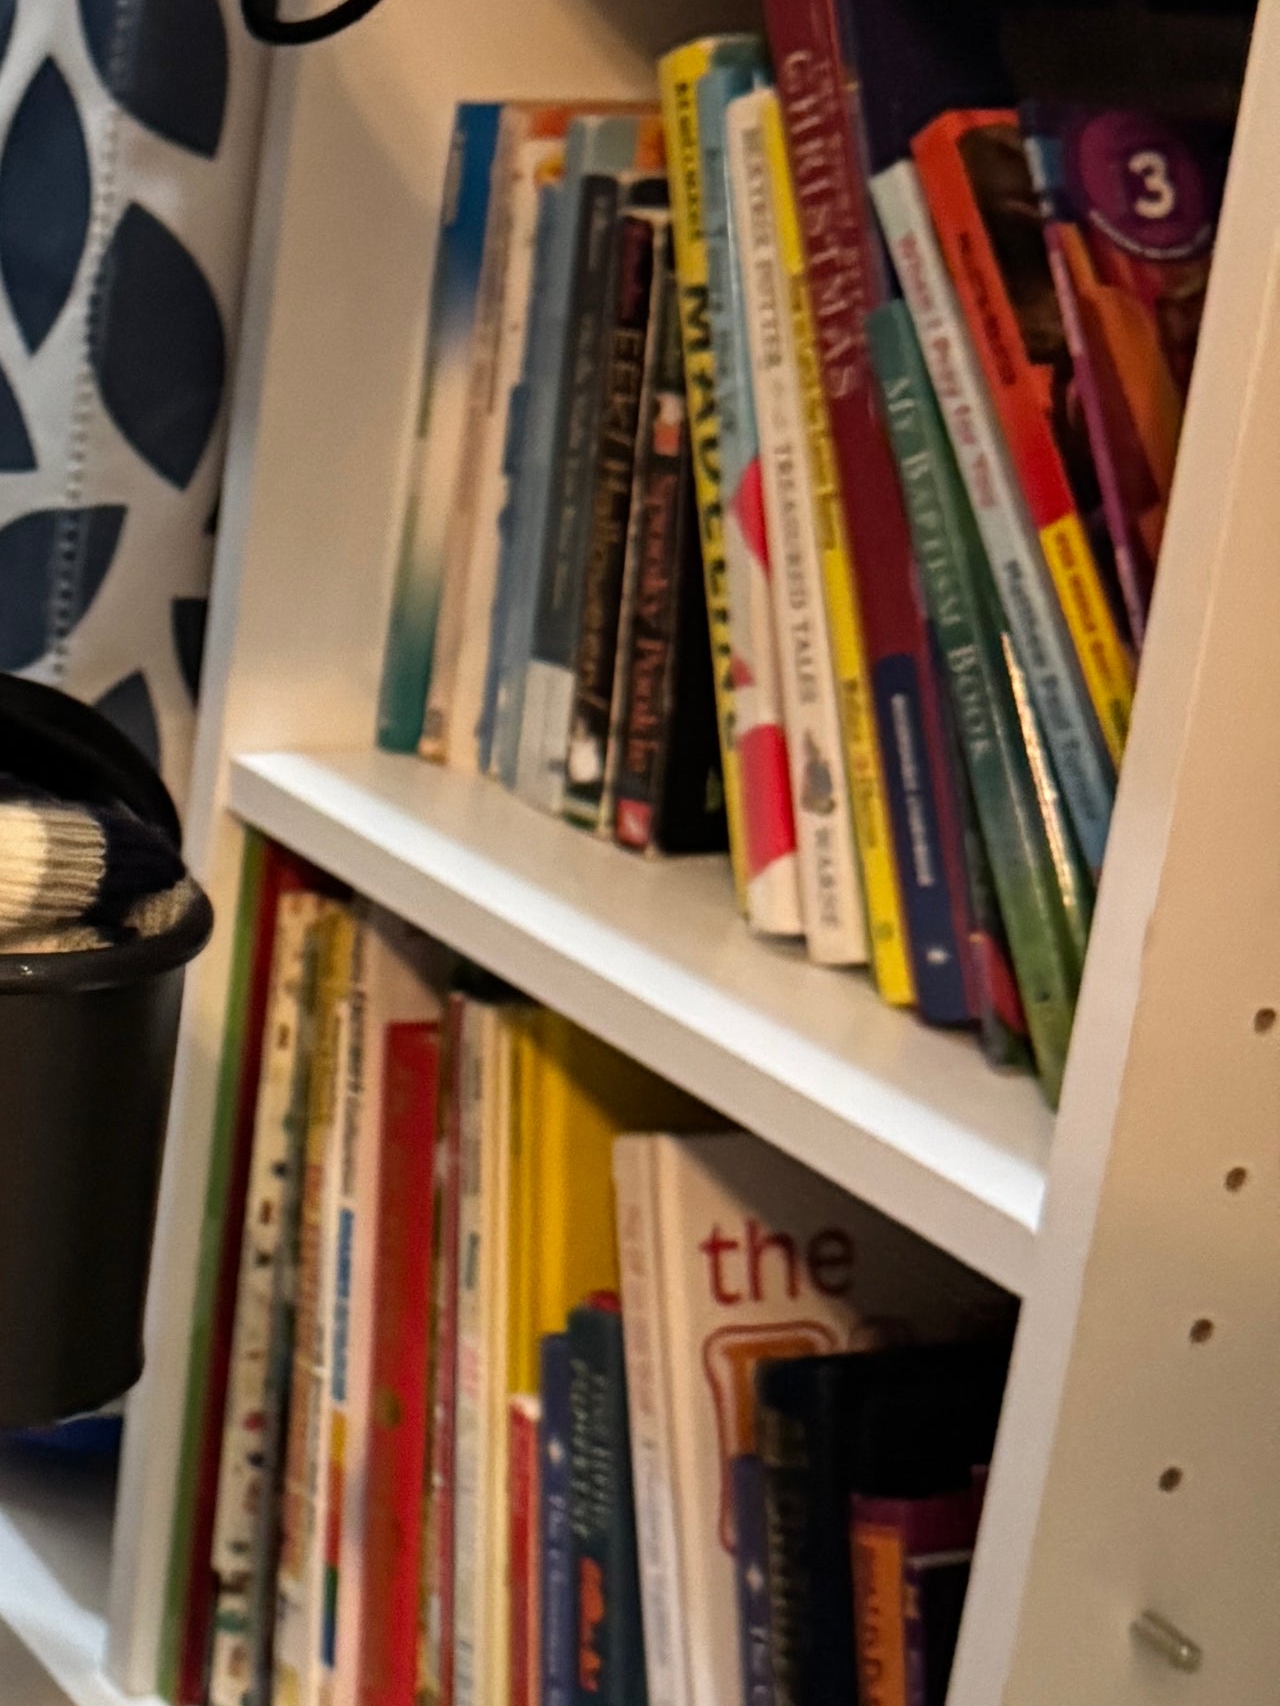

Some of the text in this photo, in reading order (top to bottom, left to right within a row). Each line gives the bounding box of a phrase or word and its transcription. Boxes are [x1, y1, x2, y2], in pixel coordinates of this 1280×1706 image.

[783, 49, 856, 396] CHRISTMAS
[1128, 151, 1175, 219] 3
[699, 1219, 856, 1307] the
